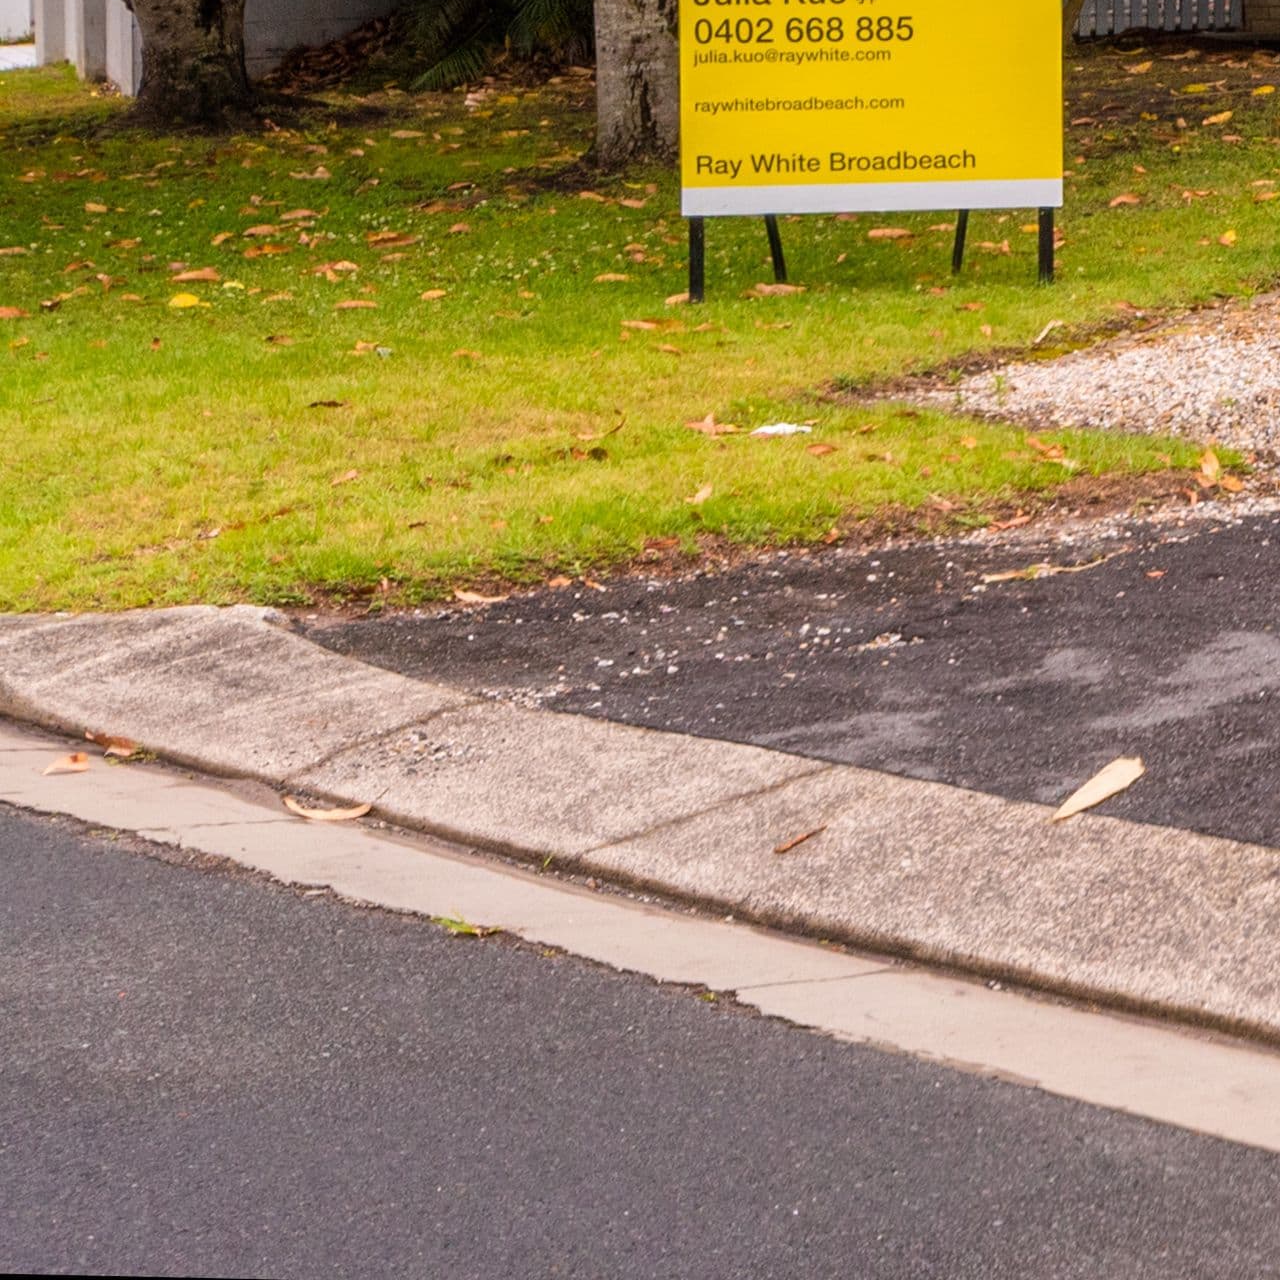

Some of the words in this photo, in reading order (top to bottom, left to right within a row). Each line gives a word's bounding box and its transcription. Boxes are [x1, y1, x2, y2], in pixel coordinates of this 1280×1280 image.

[694, 18, 774, 44] 0402
[786, 17, 845, 43] 668
[856, 16, 914, 42] 885
[693, 48, 892, 67] julia.kuo@raywhite.com
[694, 96, 905, 114] raywhitebroadbeach.com
[696, 155, 742, 179] Ray
[751, 154, 821, 173] White
[829, 150, 977, 172] Broadbeach
